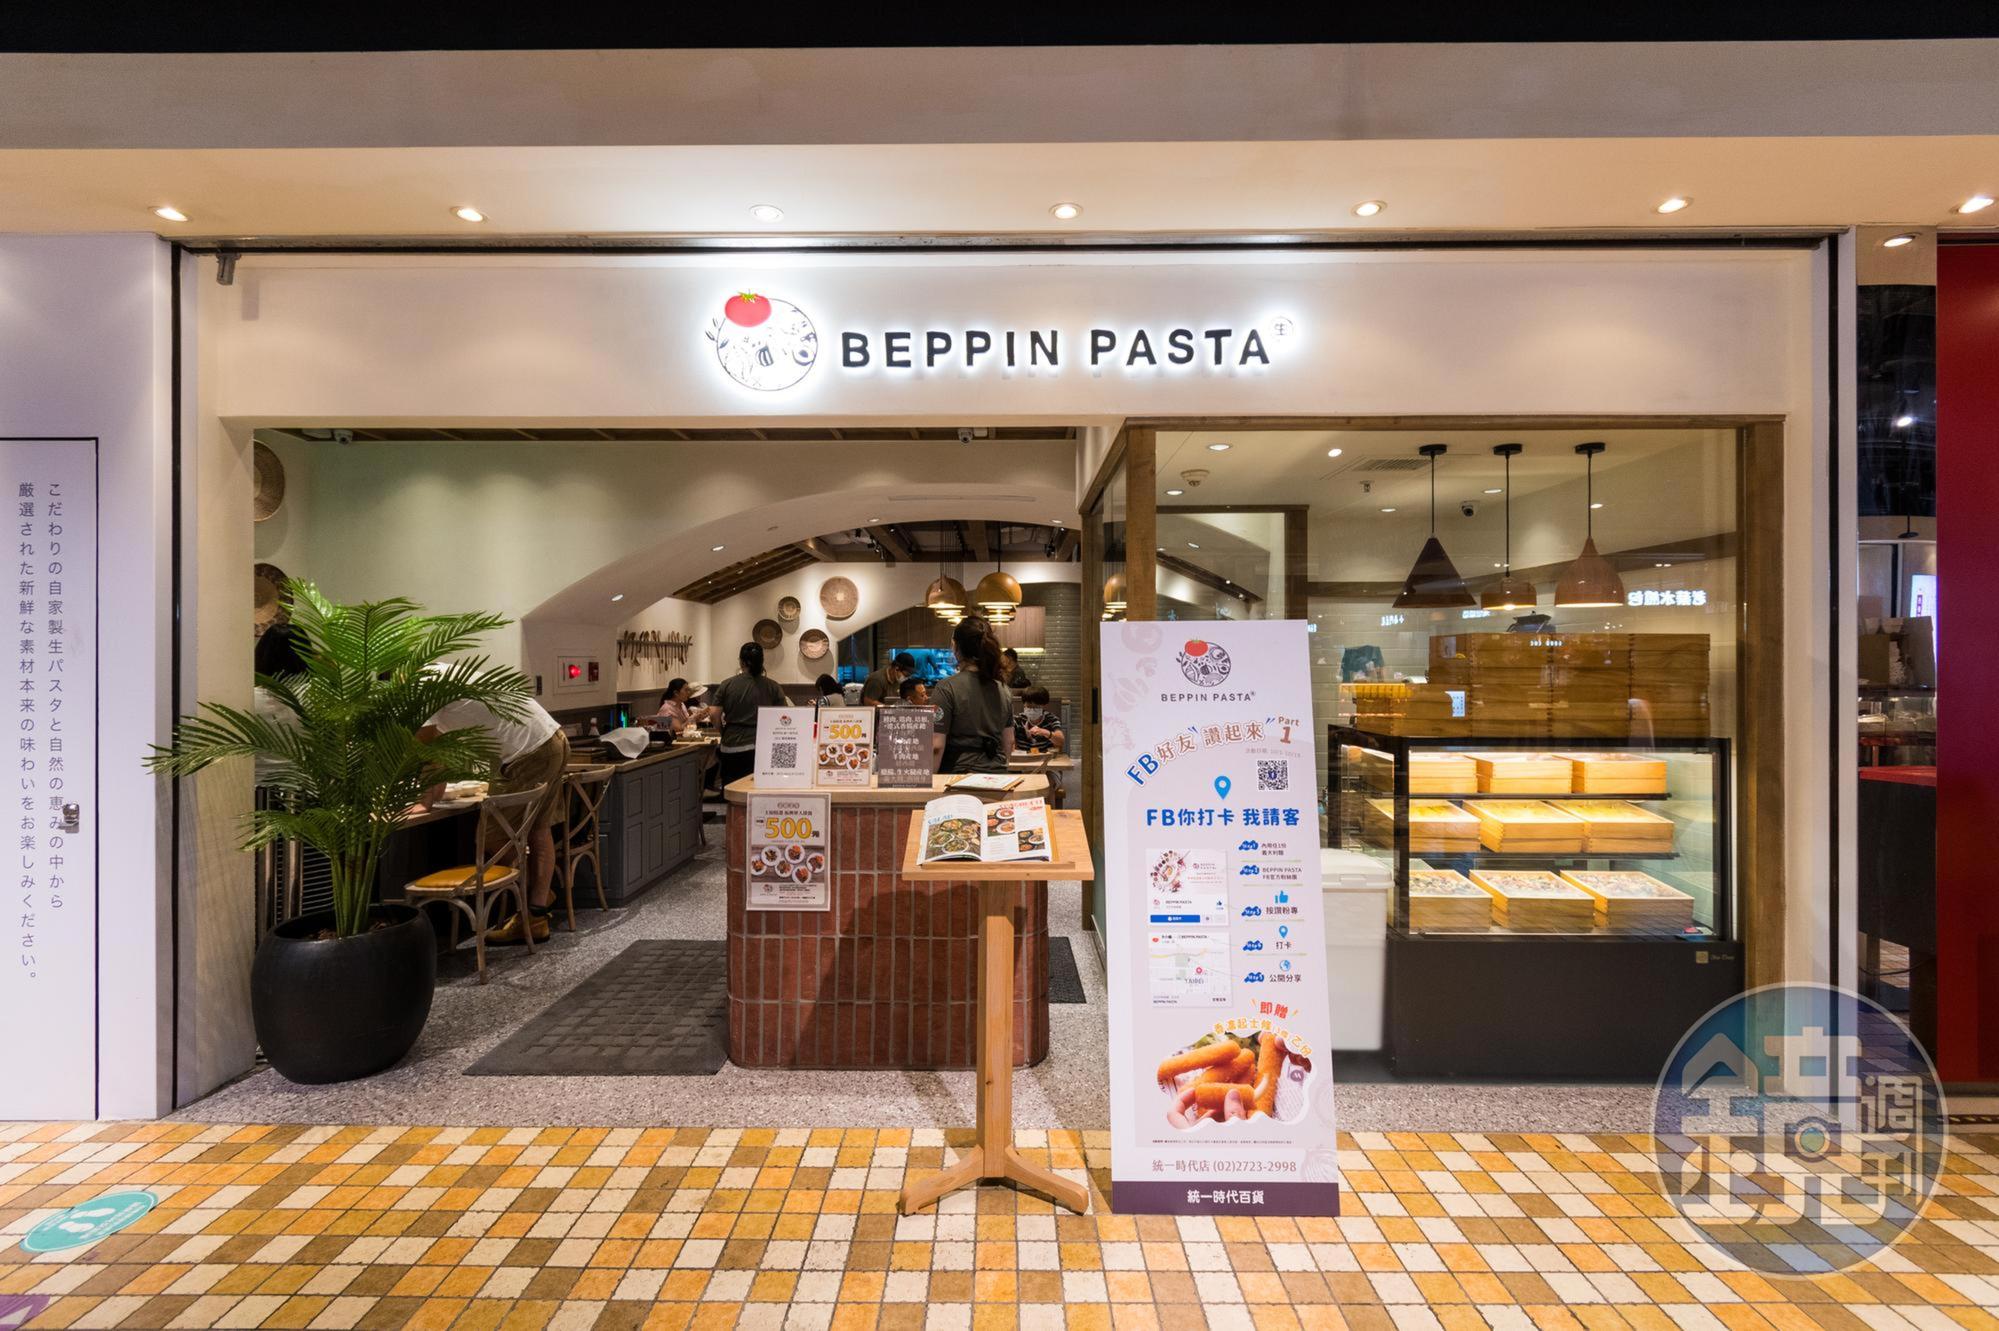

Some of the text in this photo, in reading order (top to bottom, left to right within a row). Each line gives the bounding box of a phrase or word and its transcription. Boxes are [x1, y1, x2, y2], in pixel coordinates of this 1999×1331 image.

[841, 328, 1270, 368] BEPPIN PASTA
[1160, 693, 1208, 702] BEPPIN
[1278, 716, 1300, 727] Part
[19, 482, 36, 978] 厳選された新鮮な素材本来の味わいをお楽しみください。
[829, 724, 862, 740] 500
[1280, 726, 1292, 744] 1
[1146, 808, 1300, 826] FB你打卡 我請客
[765, 817, 812, 839] 500
[1276, 942, 1292, 950] 打卡
[1269, 974, 1302, 983] 公開分享
[1260, 1001, 1289, 1019] 即贈
[1152, 1159, 1297, 1173] 統一時代店 (02)2723-2998
[1187, 1189, 1265, 1205] 統一時代百貨
